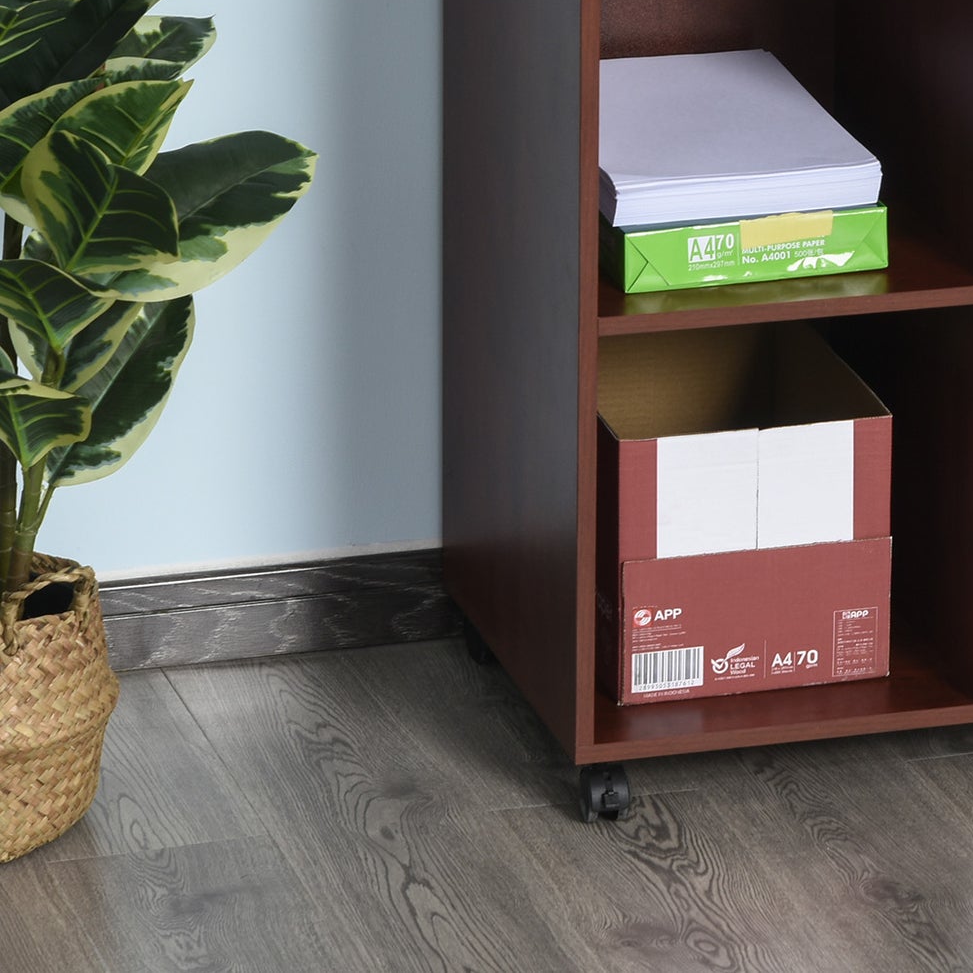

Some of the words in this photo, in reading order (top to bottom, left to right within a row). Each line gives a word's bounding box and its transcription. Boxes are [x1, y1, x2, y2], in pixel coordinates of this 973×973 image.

[689, 236, 715, 262] A4
[716, 233, 735, 249] 70
[802, 239, 825, 248] PAPER
[742, 256, 759, 264] No.
[761, 251, 791, 262] A4001
[654, 608, 682, 621] APP
[850, 609, 869, 618] APP
[771, 652, 793, 668] A4
[796, 649, 818, 666] 70
[730, 661, 756, 670] LEGAL
